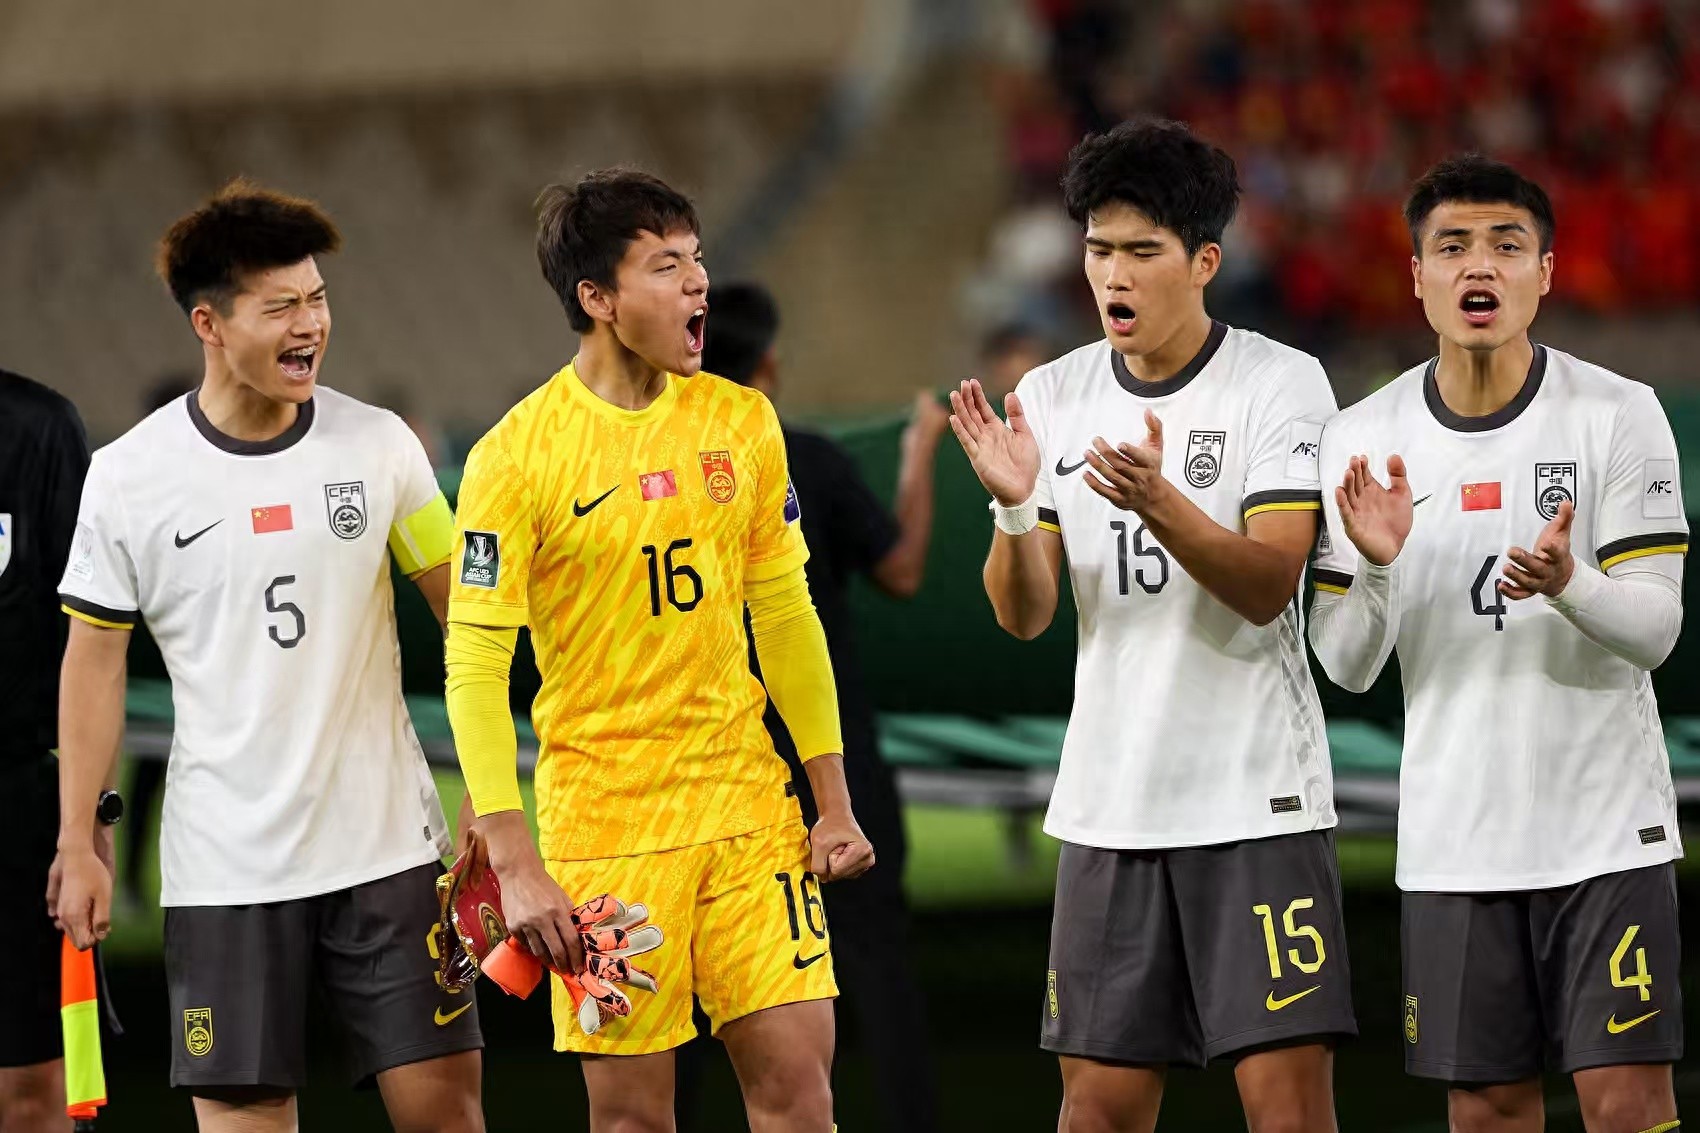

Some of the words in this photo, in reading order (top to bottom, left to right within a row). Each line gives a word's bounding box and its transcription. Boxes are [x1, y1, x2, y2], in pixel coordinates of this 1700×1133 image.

[700, 451, 729, 464] CFA
[1192, 434, 1222, 445] CFA
[1292, 441, 1318, 458] AFC
[329, 485, 360, 498] CFA
[1539, 466, 1573, 478] CFA
[1647, 480, 1672, 494] AFC
[641, 537, 704, 617] 16
[1109, 520, 1169, 596] 15
[265, 574, 306, 649] 5
[1470, 554, 1507, 632] 4
[775, 871, 826, 941] 16
[1252, 897, 1326, 979] 15
[1609, 925, 1652, 1002] 4
[186, 1010, 209, 1022] CFA
